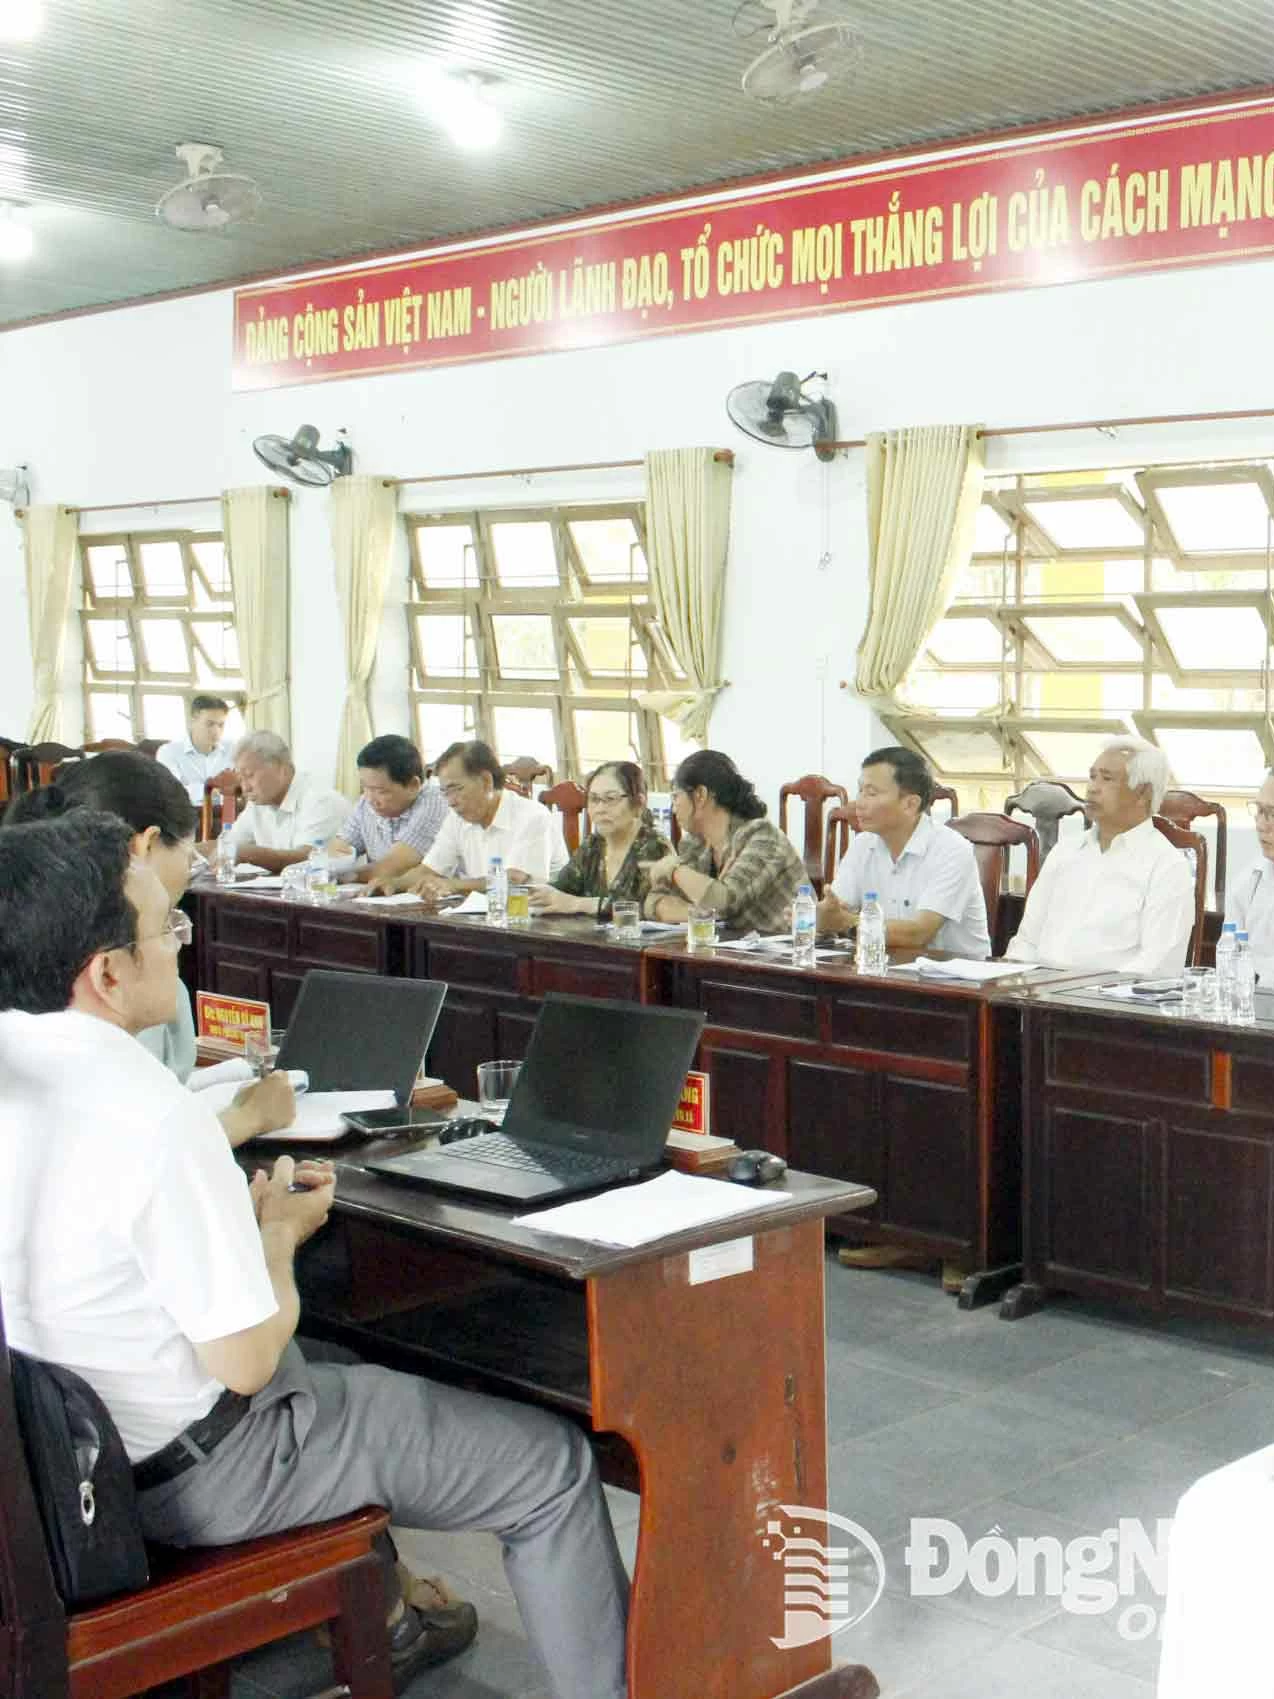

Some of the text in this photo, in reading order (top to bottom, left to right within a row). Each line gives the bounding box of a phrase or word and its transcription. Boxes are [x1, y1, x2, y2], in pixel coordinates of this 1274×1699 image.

[292, 303, 340, 367] CỘNG
[343, 288, 380, 352] SẢN
[384, 287, 423, 355] VIỆT
[427, 286, 473, 340] NAM
[490, 261, 553, 331] NGƯỜI
[560, 256, 617, 320] LÃNH
[622, 252, 674, 319] ĐẠO,
[680, 223, 712, 301] TỔ
[717, 224, 784, 297] CHỨC
[792, 223, 843, 294] MỌI
[851, 191, 943, 276] THẮNG
[952, 191, 998, 272] LỢI
[1008, 167, 1074, 252] CỦA
[1080, 162, 1169, 242] CÁCH
